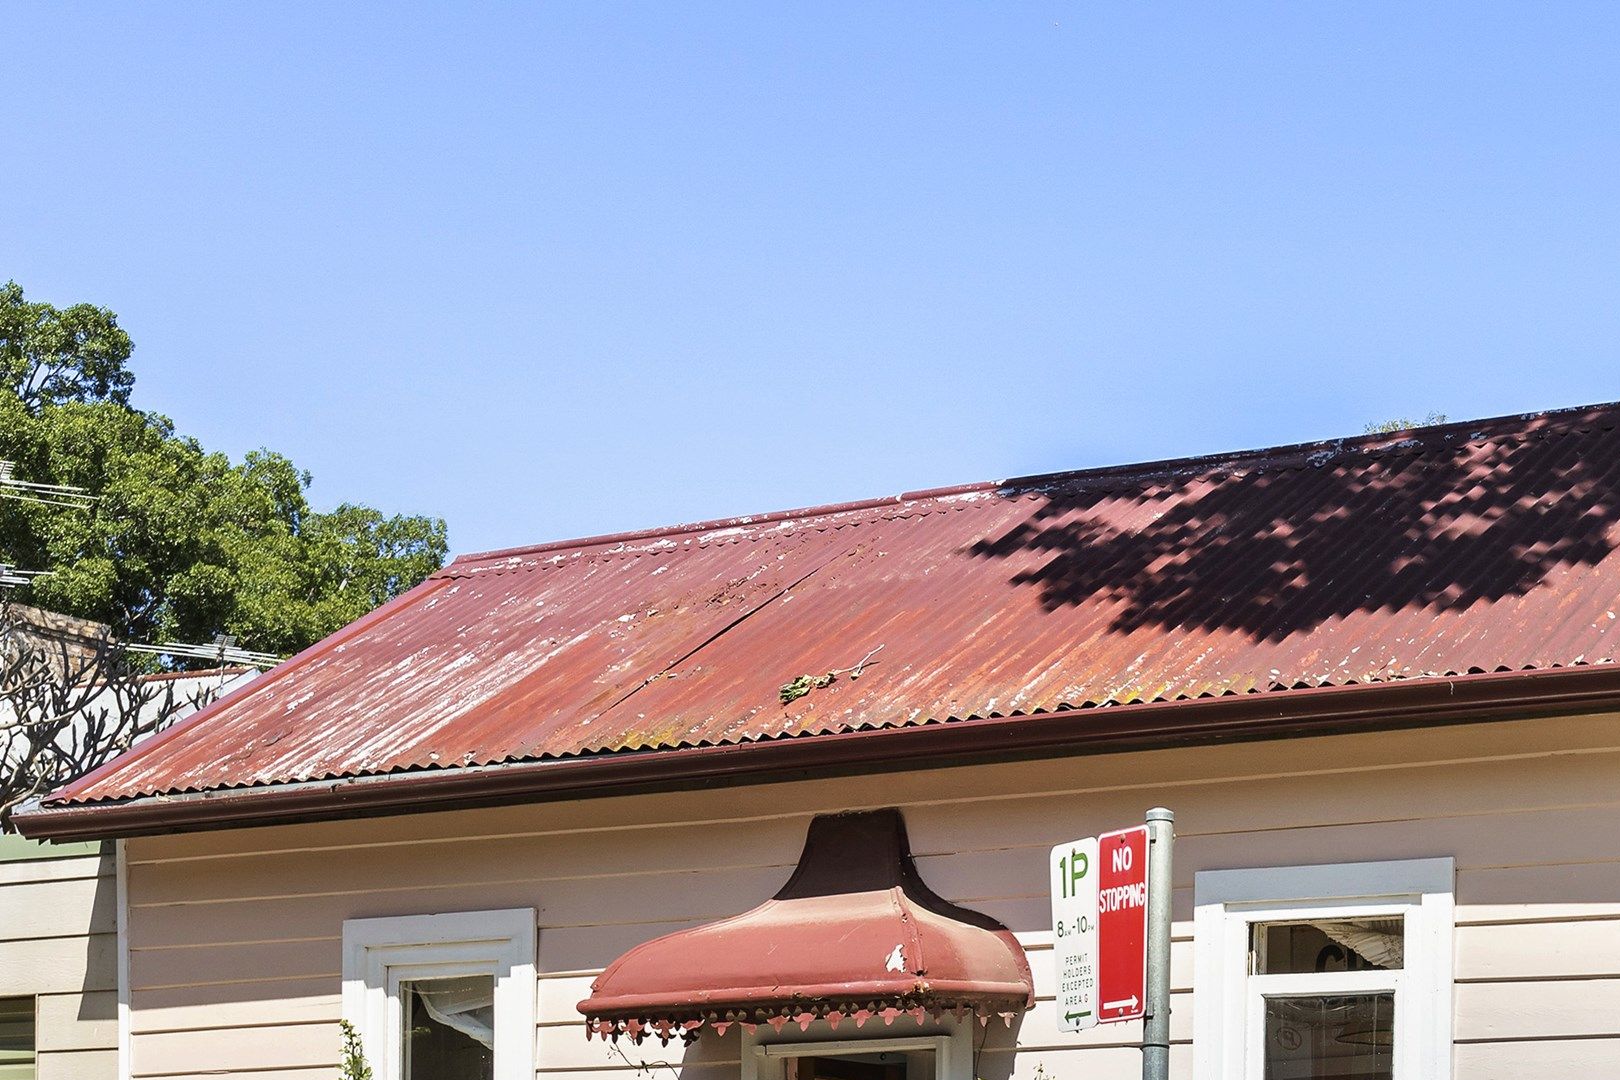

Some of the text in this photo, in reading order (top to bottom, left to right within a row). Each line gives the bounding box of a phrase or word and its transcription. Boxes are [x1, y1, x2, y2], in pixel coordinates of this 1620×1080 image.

[1112, 846, 1132, 873] NO
[1059, 852, 1089, 899] 1P
[1099, 882, 1145, 913] STOPPING
[1065, 952, 1089, 965] PERMIT
[1063, 965, 1092, 978] HOLDERS
[1062, 978, 1094, 993] EXCEPTED
[1065, 995, 1082, 1006] AREA
